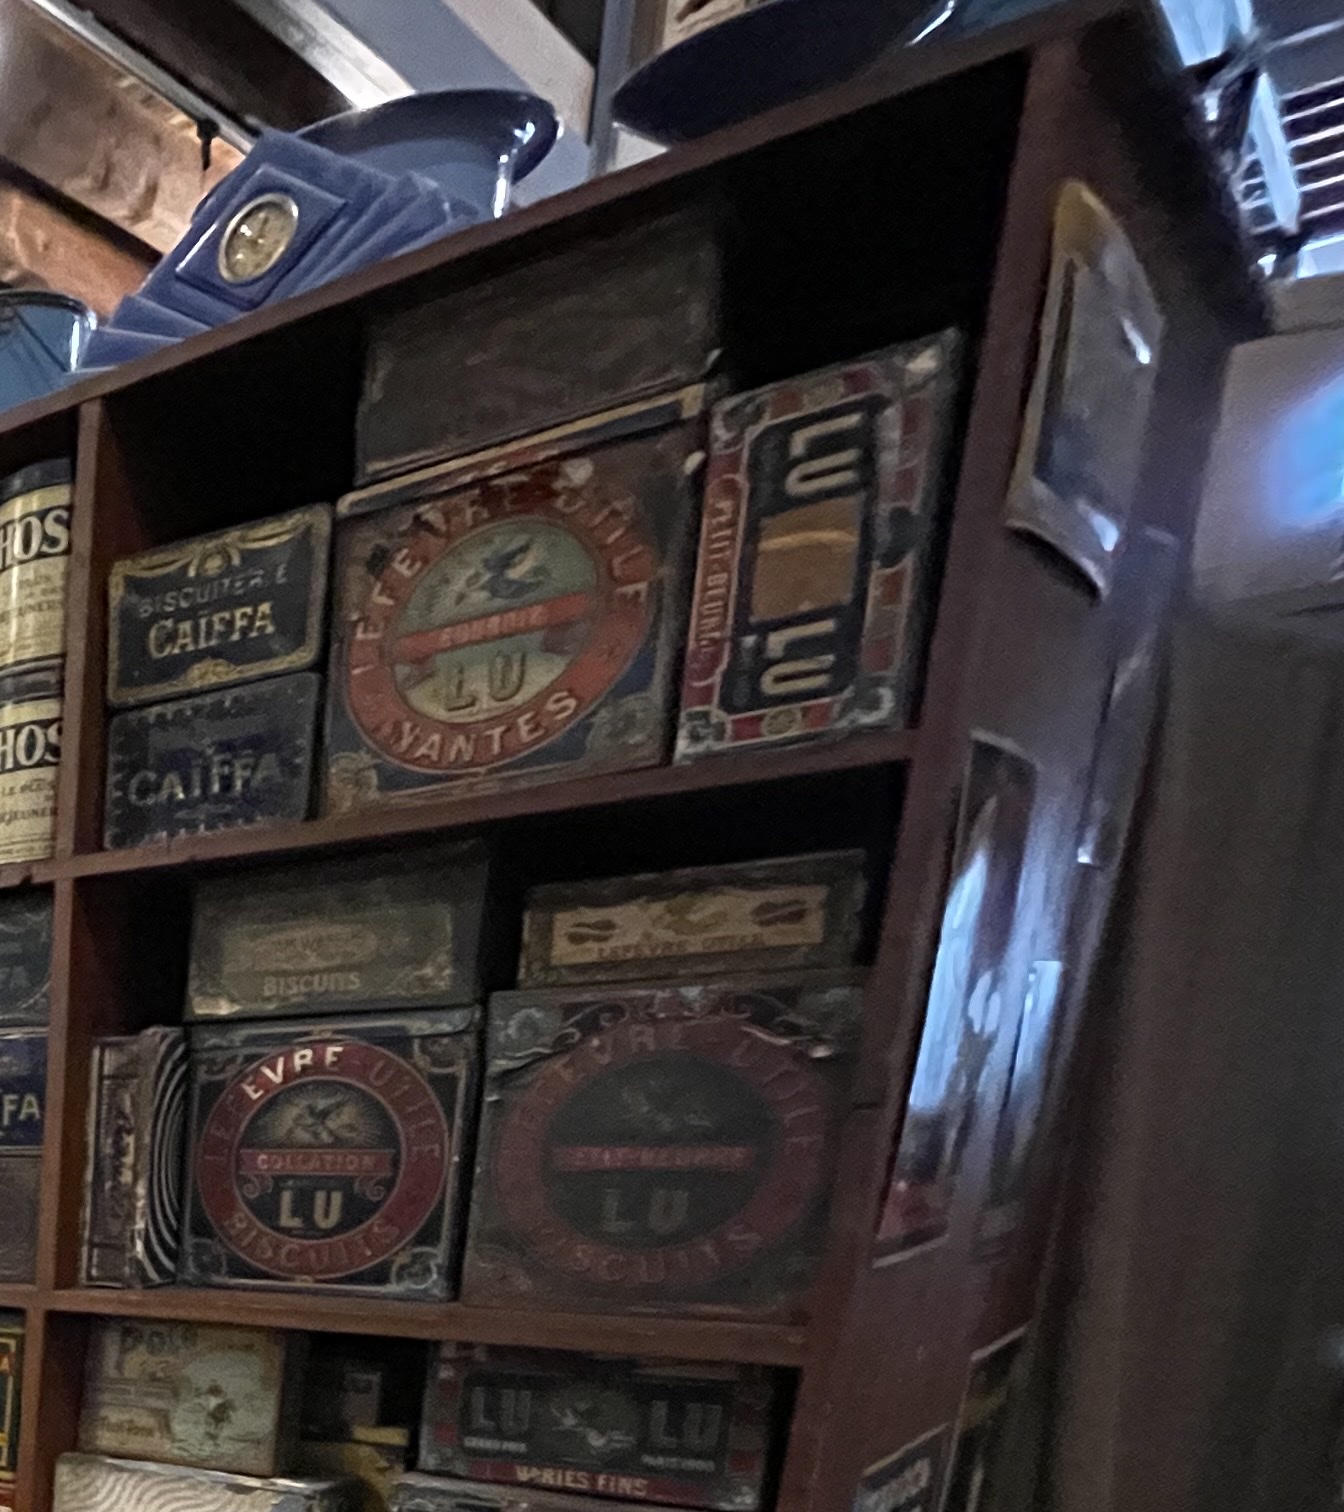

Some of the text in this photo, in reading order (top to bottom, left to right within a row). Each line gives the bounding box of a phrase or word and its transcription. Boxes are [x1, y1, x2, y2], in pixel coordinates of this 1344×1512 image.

[787, 411, 868, 498] LU
[445, 651, 528, 712] LU
[759, 618, 839, 696] LU
[280, 1188, 343, 1230] LU
[470, 1385, 532, 1435] LU
[648, 1398, 724, 1450] LU
[596, 1470, 650, 1497] FINS
